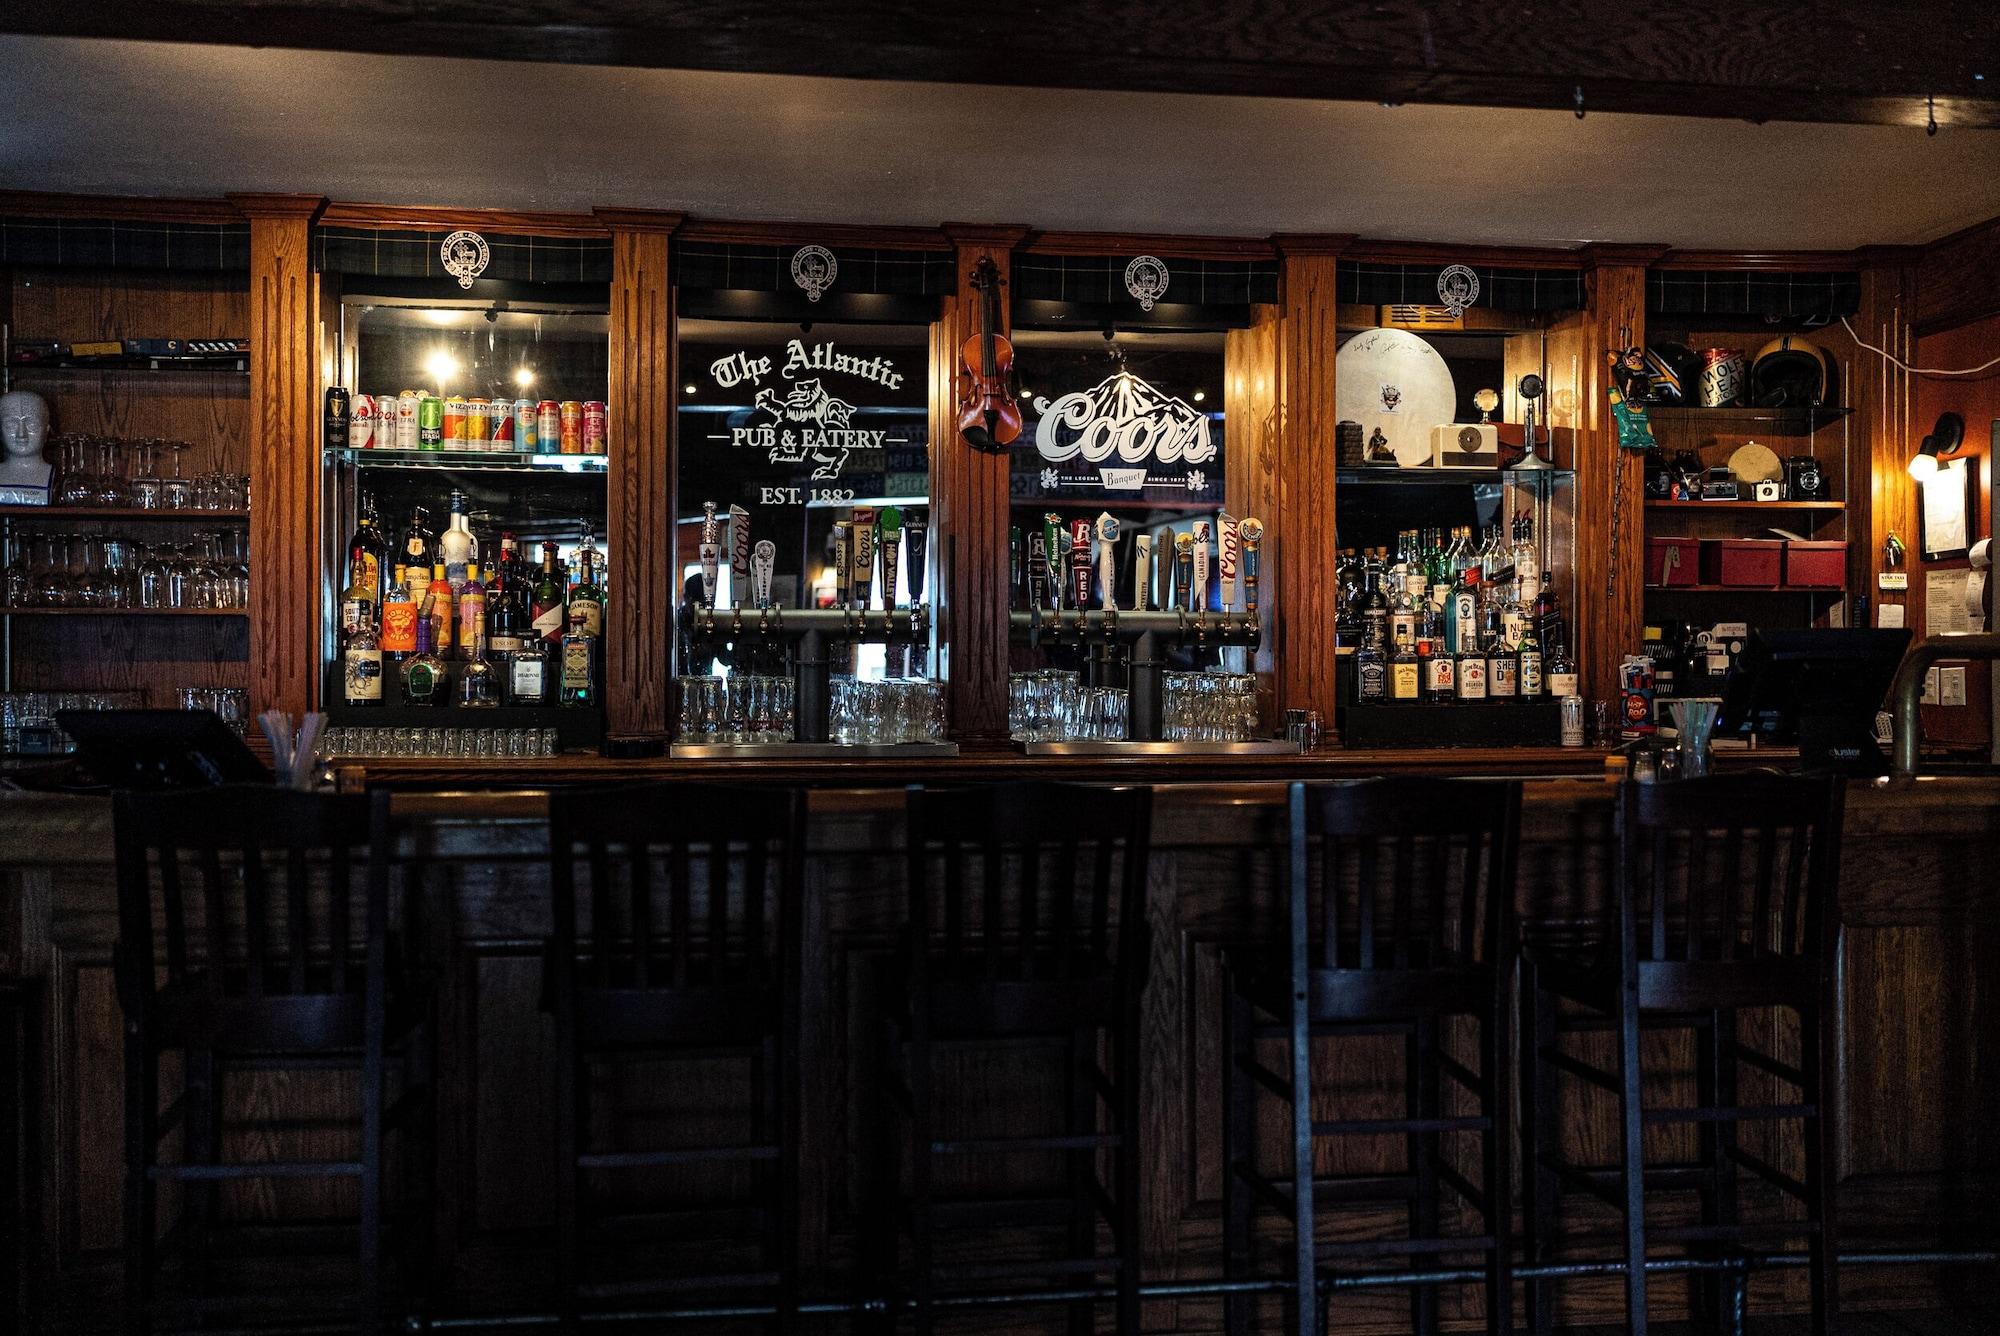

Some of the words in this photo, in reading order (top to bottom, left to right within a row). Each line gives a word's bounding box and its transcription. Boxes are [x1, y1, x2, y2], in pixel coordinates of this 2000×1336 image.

[711, 351, 772, 388] The
[782, 339, 905, 390] Atlantic
[732, 427, 776, 447] PUB
[780, 429, 797, 447] &
[801, 429, 886, 448] EATERY
[1033, 392, 1217, 464] Coors
[1106, 472, 1141, 486] Banquet
[760, 487, 803, 504] EST.
[809, 488, 856, 503] 1882
[856, 529, 871, 569] Coors
[886, 543, 897, 564] HOP
[1220, 520, 1238, 579] Coors
[886, 565, 897, 599] VALLEY
[1080, 571, 1088, 601] RED
[386, 608, 415, 620] HOWLER
[571, 602, 599, 611] JAMESON
[390, 632, 410, 641] HEAD
